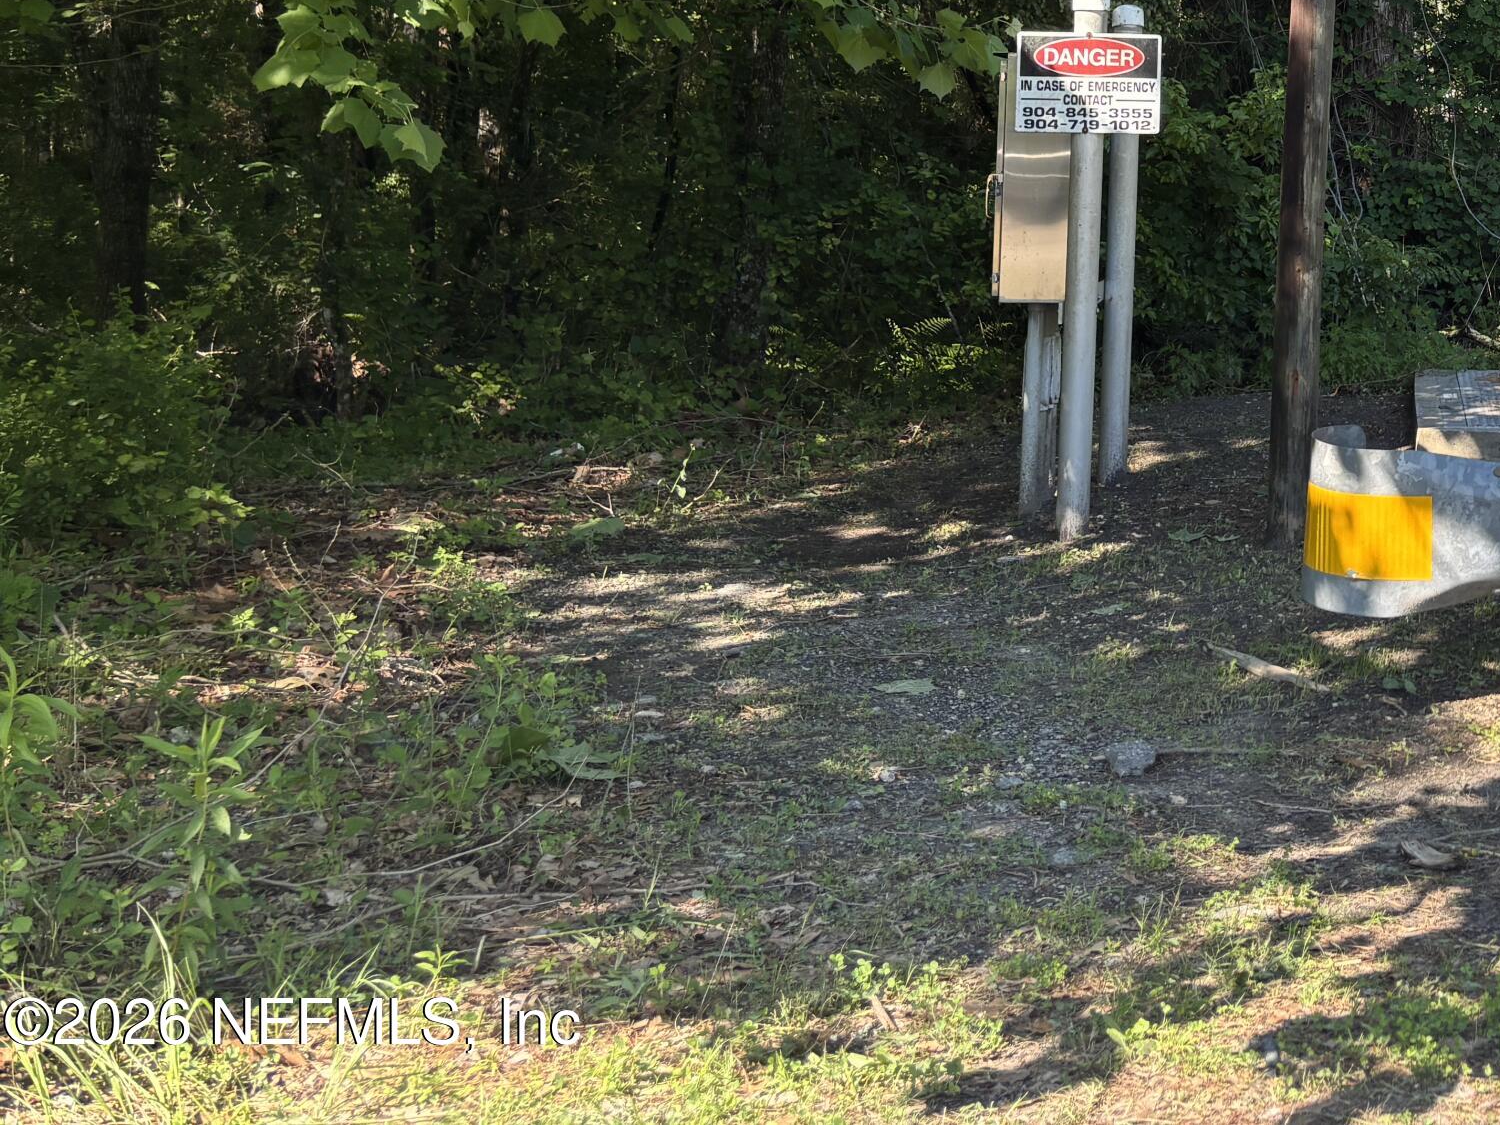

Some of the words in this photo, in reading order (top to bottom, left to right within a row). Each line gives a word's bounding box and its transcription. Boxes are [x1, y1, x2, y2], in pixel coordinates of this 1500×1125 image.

[1043, 48, 1135, 67] DANGER
[1020, 80, 1032, 91] IN
[1036, 80, 1065, 91] CASE
[1069, 81, 1084, 92] OF
[1088, 81, 1156, 93] EMERGENCY
[1063, 94, 1114, 106] CONTACT
[1022, 107, 1153, 119] 904-845-3555
[1023, 119, 1151, 130] 904-719-1012
